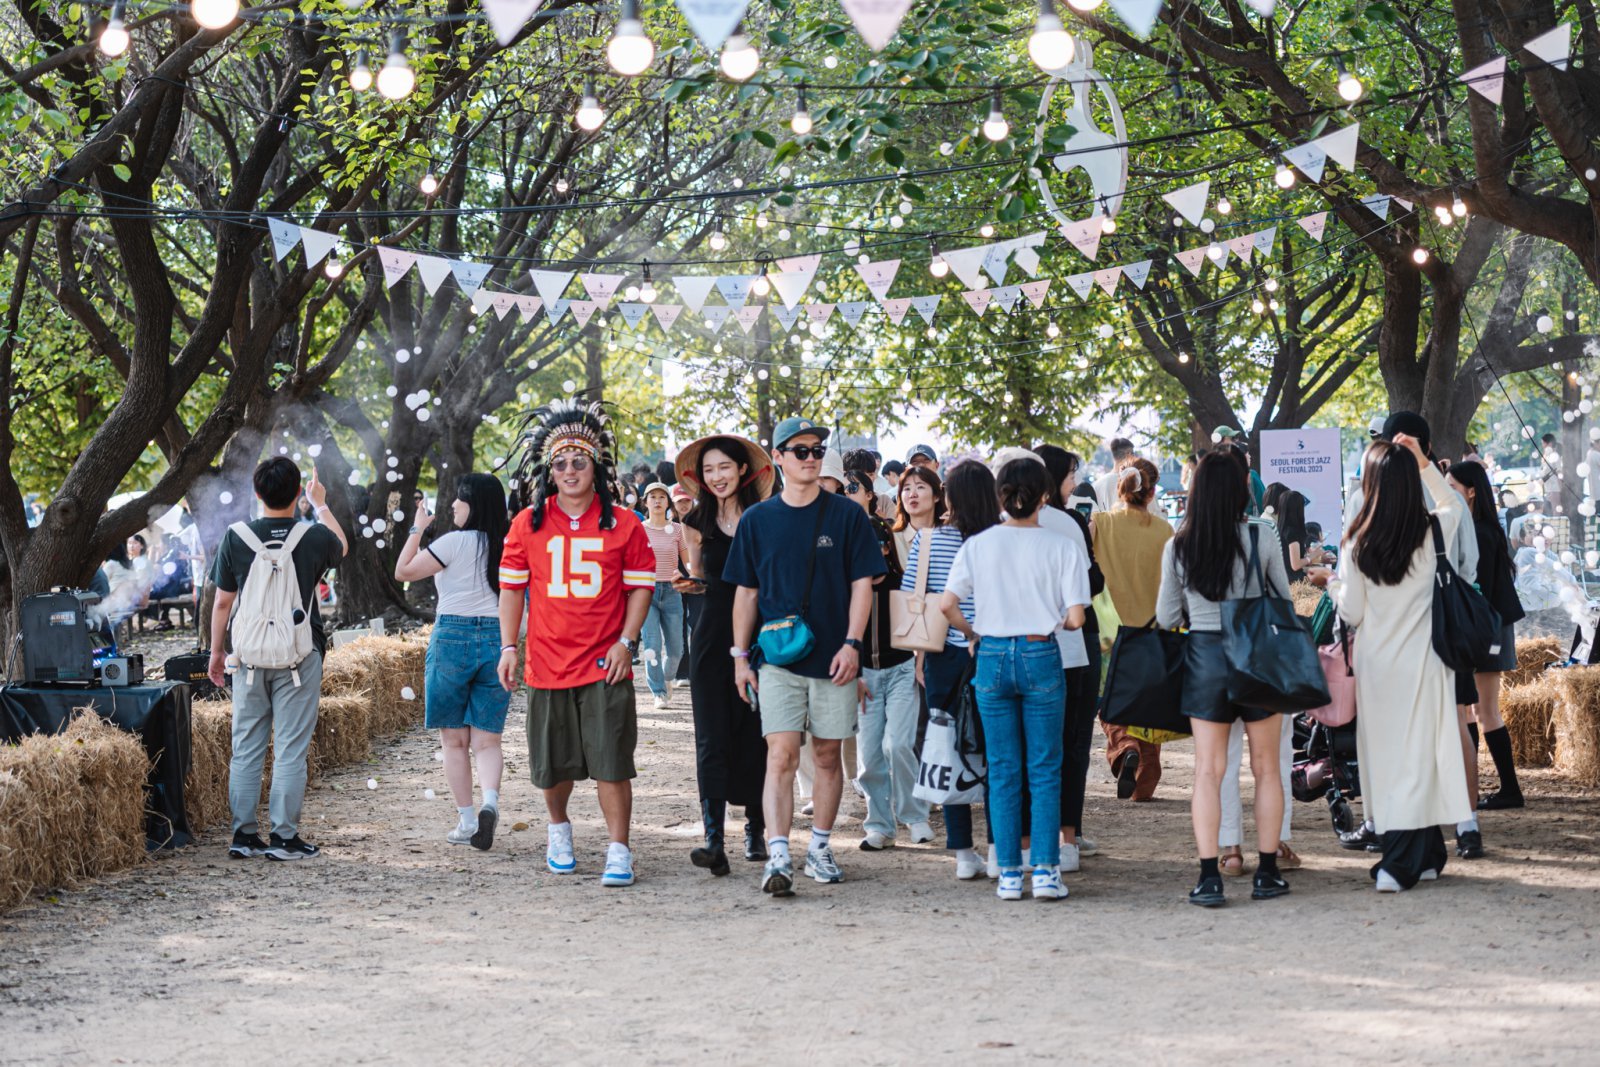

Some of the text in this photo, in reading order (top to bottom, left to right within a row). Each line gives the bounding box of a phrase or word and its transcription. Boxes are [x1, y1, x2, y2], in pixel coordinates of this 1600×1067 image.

[1270, 456, 1331, 466] SEOUL FOREST JAZZ
[1279, 465, 1323, 474] FESTIVAL 2023
[546, 535, 603, 598] 15
[917, 762, 952, 791] IKE
